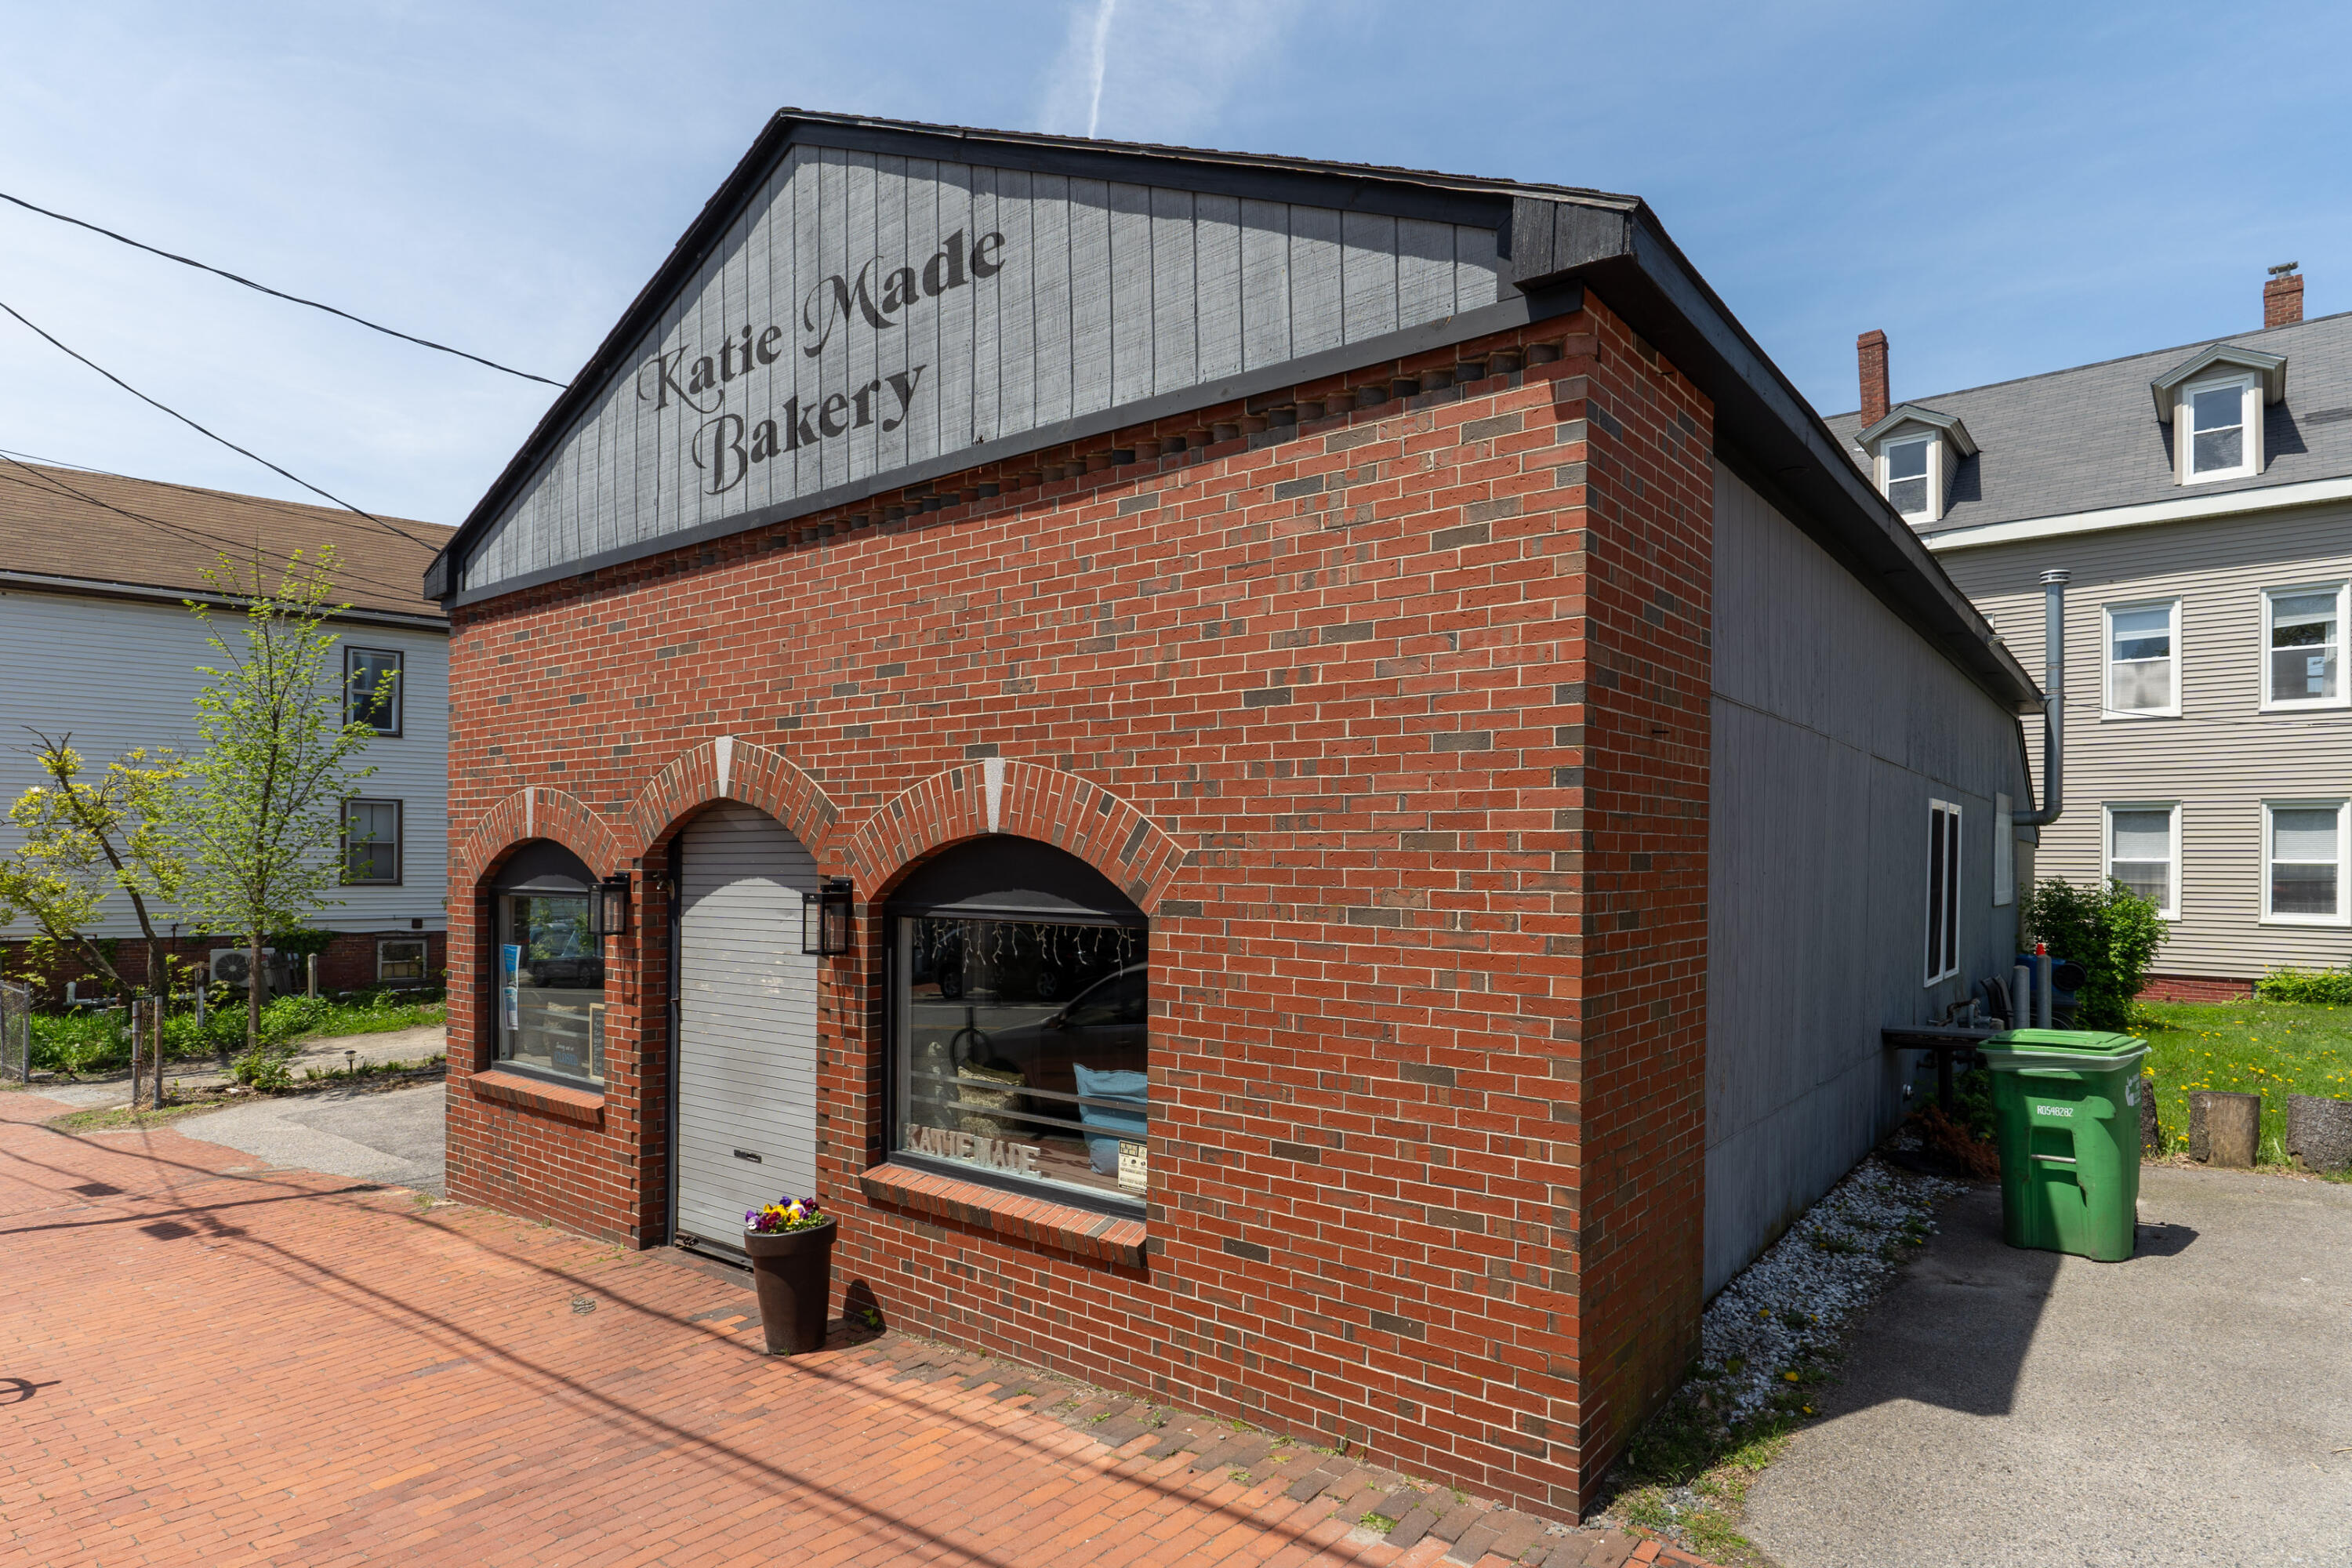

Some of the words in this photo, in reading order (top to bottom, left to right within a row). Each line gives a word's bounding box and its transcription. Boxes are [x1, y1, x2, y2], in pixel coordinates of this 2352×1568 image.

[637, 324, 782, 414] Katie
[803, 227, 1007, 358] Made
[691, 365, 927, 495] Bakery
[904, 1123, 975, 1160] KATIE
[973, 1135, 1042, 1179] MADE
